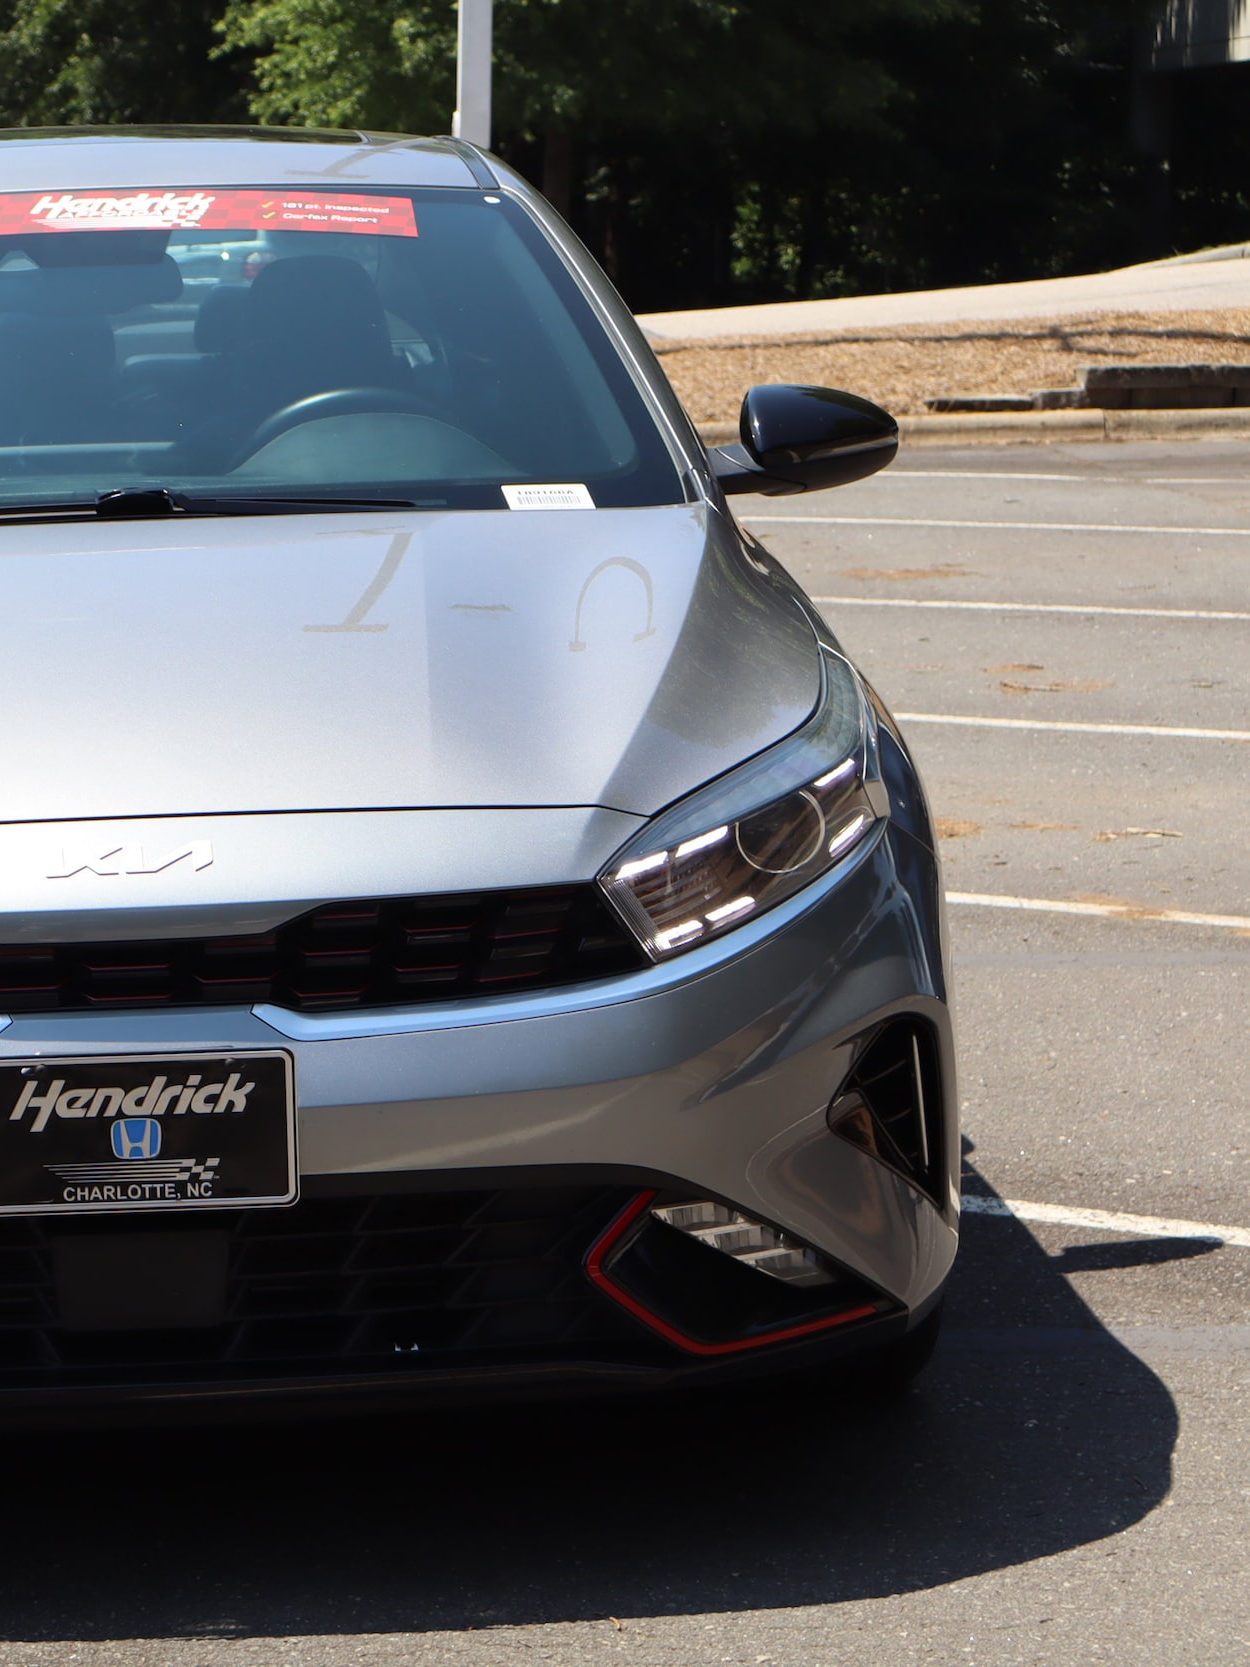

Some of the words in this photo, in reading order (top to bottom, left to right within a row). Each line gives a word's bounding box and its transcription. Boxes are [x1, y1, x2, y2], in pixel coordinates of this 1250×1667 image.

[29, 192, 216, 220] Hendrick
[283, 212, 329, 221] Carfax
[331, 214, 378, 224] Report
[8, 1072, 256, 1133] Hendrick
[62, 1182, 182, 1201] CHARLOTTE,
[186, 1181, 214, 1198] NC
